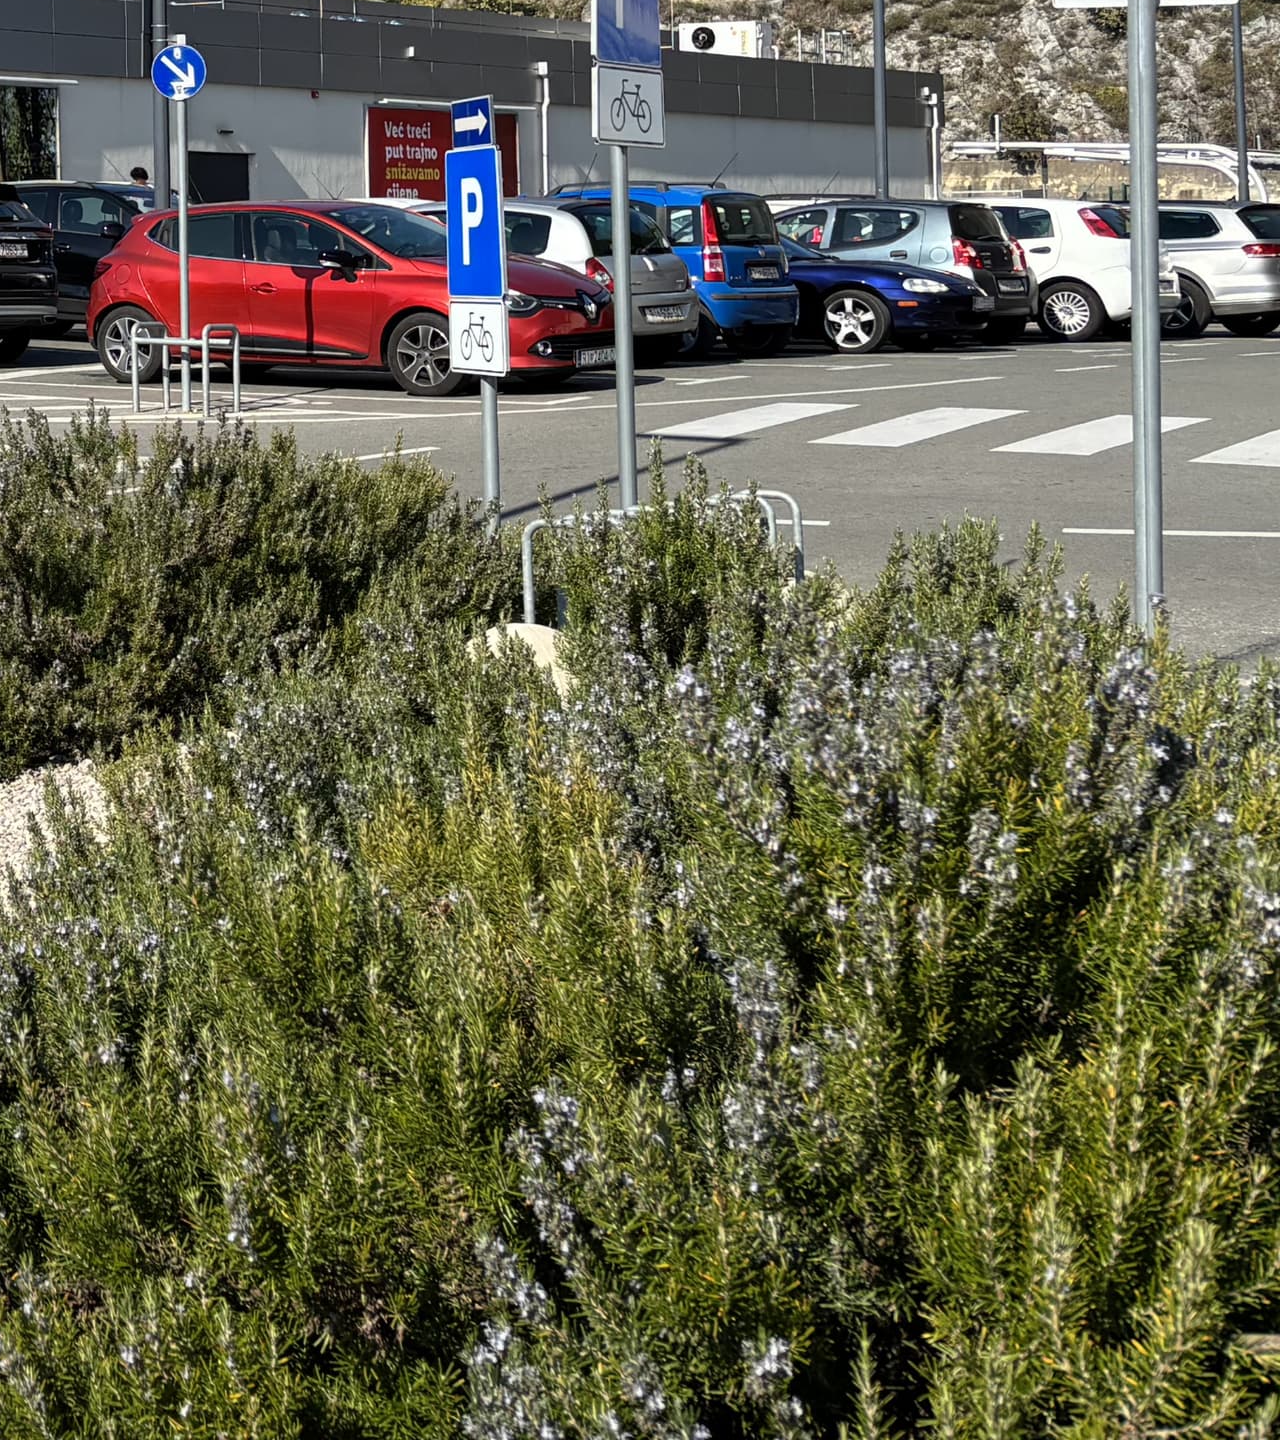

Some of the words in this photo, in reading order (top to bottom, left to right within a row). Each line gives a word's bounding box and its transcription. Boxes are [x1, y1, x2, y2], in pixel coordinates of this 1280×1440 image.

[384, 120, 405, 138] Već
[406, 121, 432, 139] treći
[385, 144, 404, 163] put
[406, 142, 438, 164] trajno
[385, 162, 441, 180] snižavamo
[460, 176, 484, 266] P
